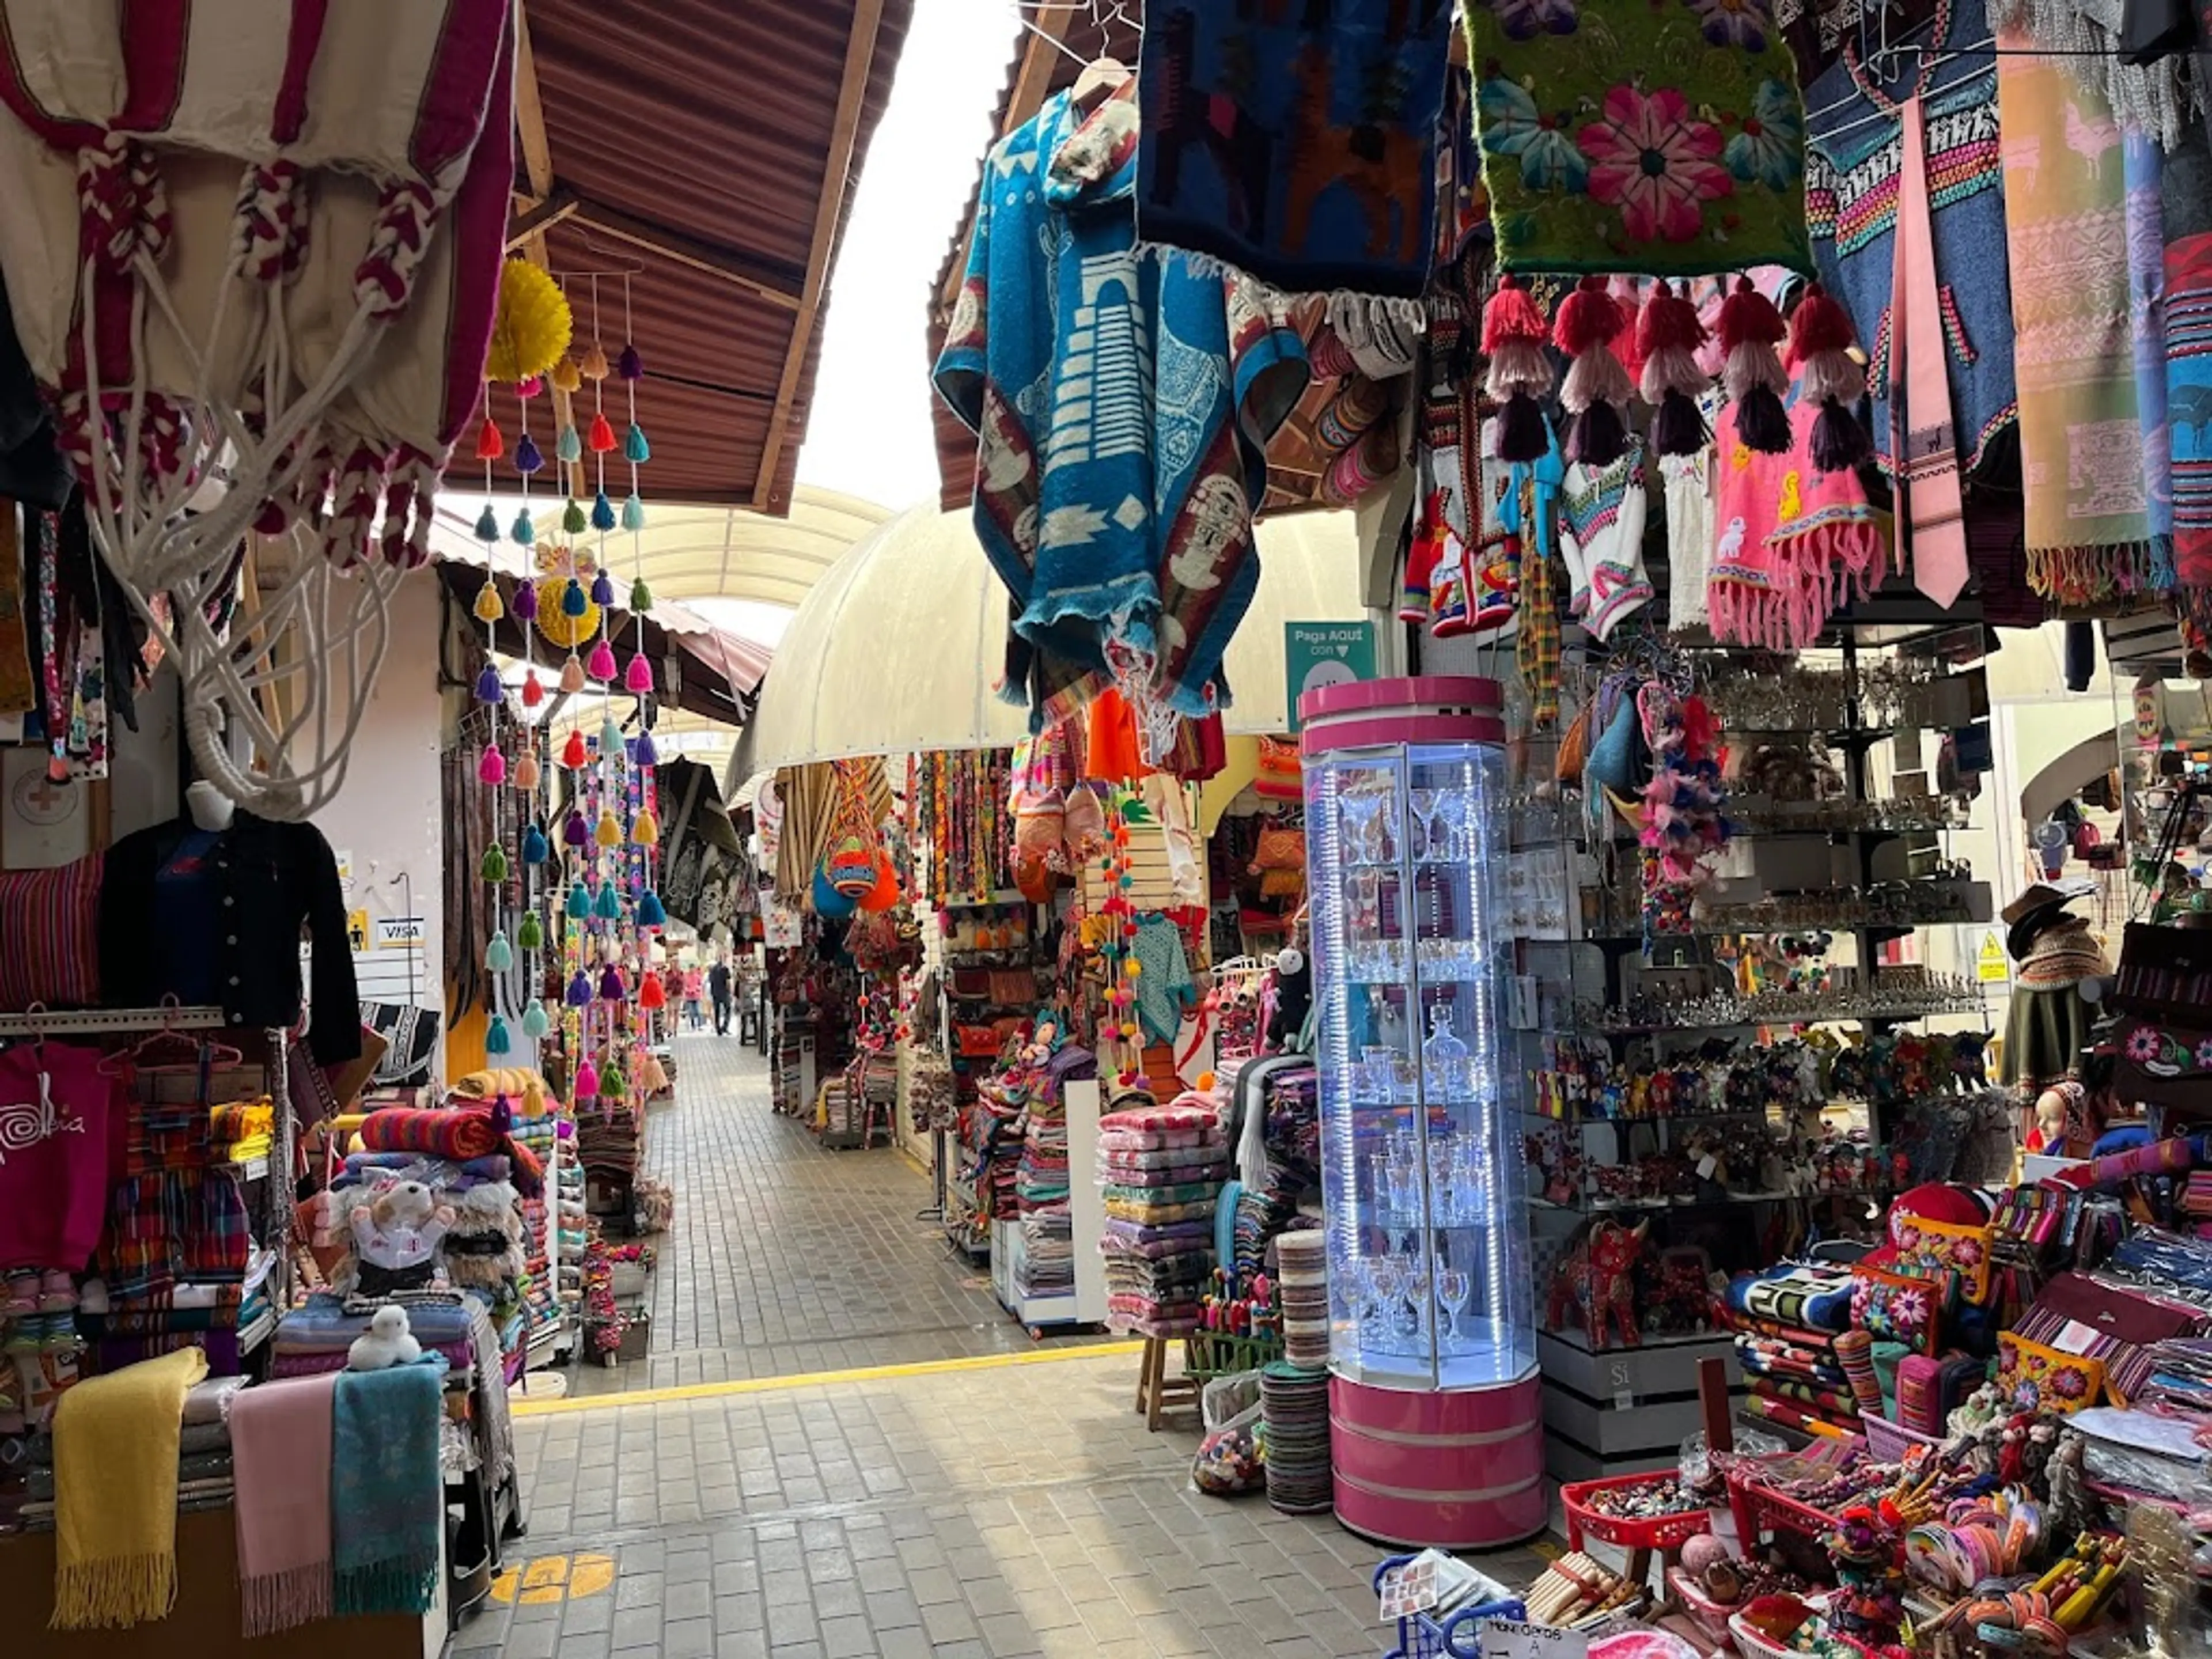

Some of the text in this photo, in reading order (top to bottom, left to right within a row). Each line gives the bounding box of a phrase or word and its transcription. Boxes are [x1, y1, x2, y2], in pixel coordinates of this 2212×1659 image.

[1295, 630, 1325, 644] Paga
[1310, 646, 1334, 655] con
[385, 926, 419, 938] VISA
